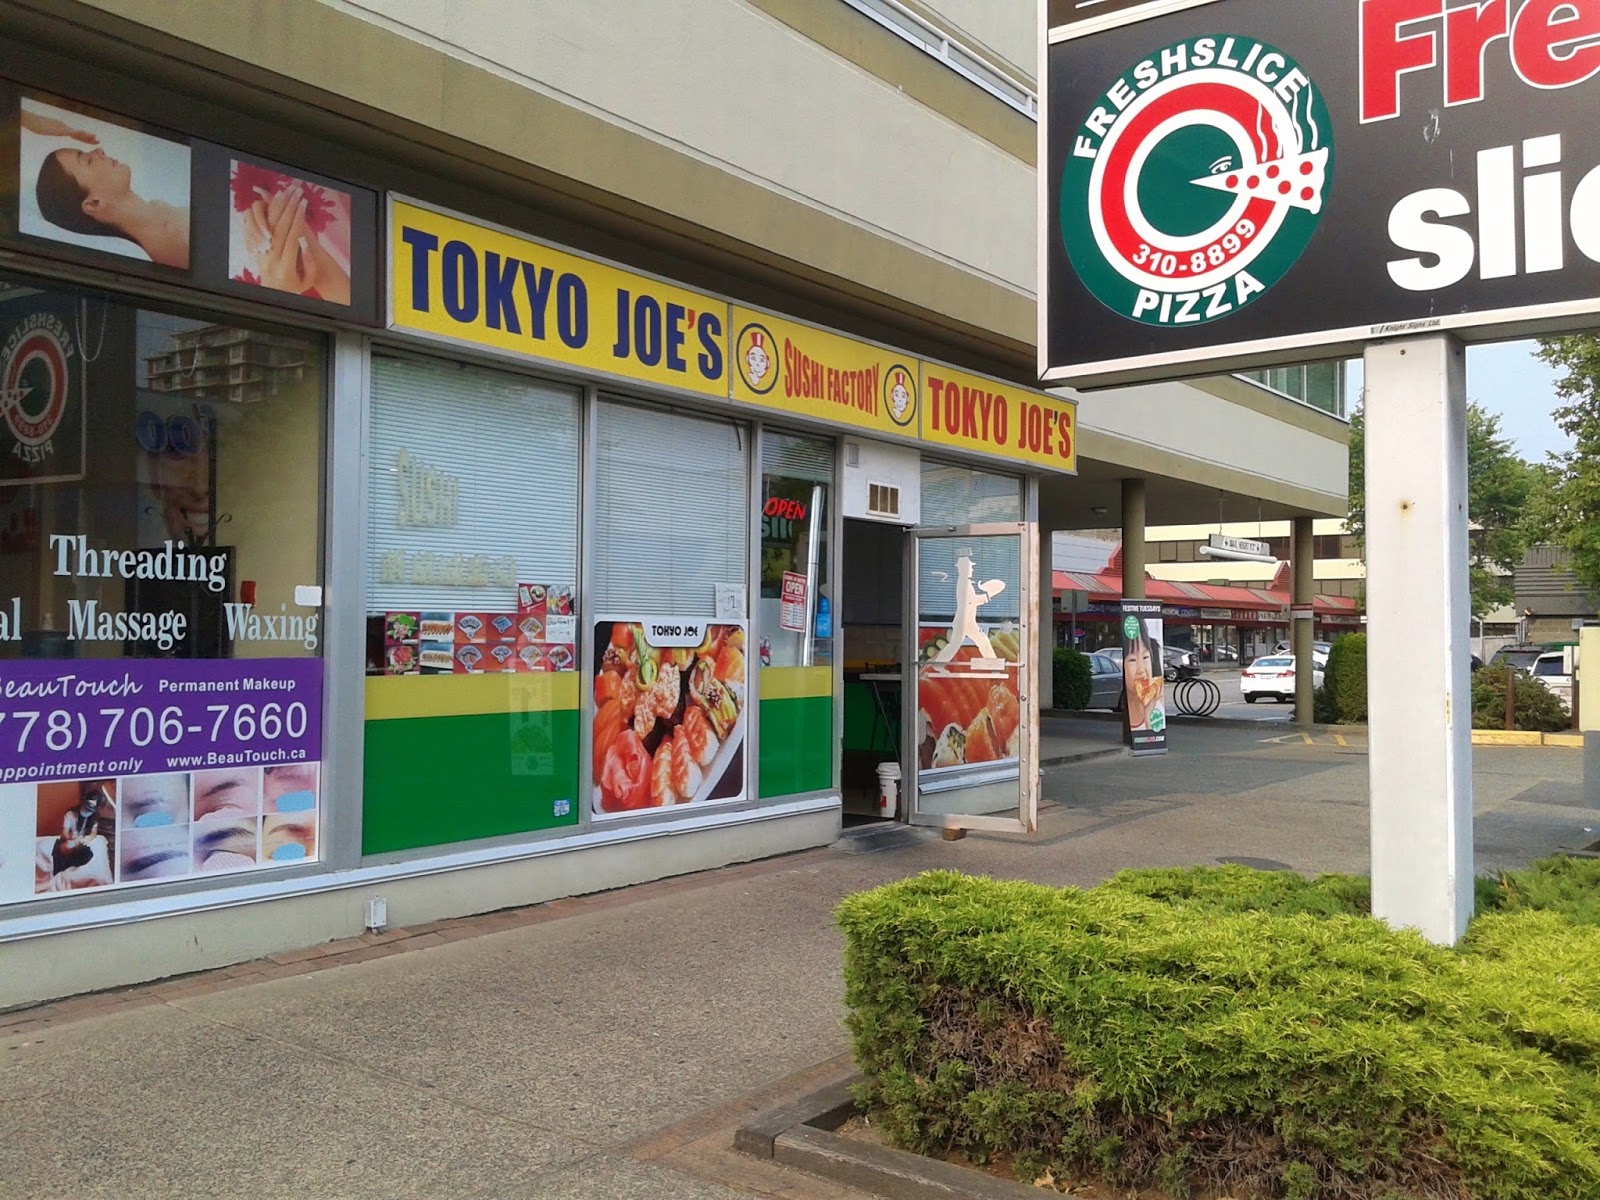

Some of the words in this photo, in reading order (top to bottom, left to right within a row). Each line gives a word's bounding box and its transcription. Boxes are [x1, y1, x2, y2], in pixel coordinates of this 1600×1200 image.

[1359, 0, 1600, 124] Fre
[1073, 37, 1308, 159] FRESHSLICE
[1132, 217, 1257, 276] 310-8899
[402, 225, 589, 349] TOKYO
[613, 288, 723, 380] JOE'S
[1132, 270, 1266, 323] PIZZA
[784, 337, 825, 400] SUSHI
[827, 362, 880, 417] FACTORY
[928, 376, 1008, 446] TOKYO
[1018, 401, 1071, 460] JOE'S
[764, 496, 807, 520] OPEN
[50, 534, 227, 592] Threading
[785, 580, 804, 596] OPEN
[67, 599, 187, 650] Massage
[224, 602, 319, 650] Waxing
[652, 625, 682, 637] TOKYO
[0, 673, 143, 699] eauTouch
[159, 679, 239, 693] Permanent
[243, 678, 296, 692] Makeup
[0, 709, 88, 752] 78)
[100, 701, 308, 748] 706-7660
[0, 760, 104, 782] ppointment
[108, 757, 143, 775] only
[166, 748, 306, 768] www.BeauTouch.ca
